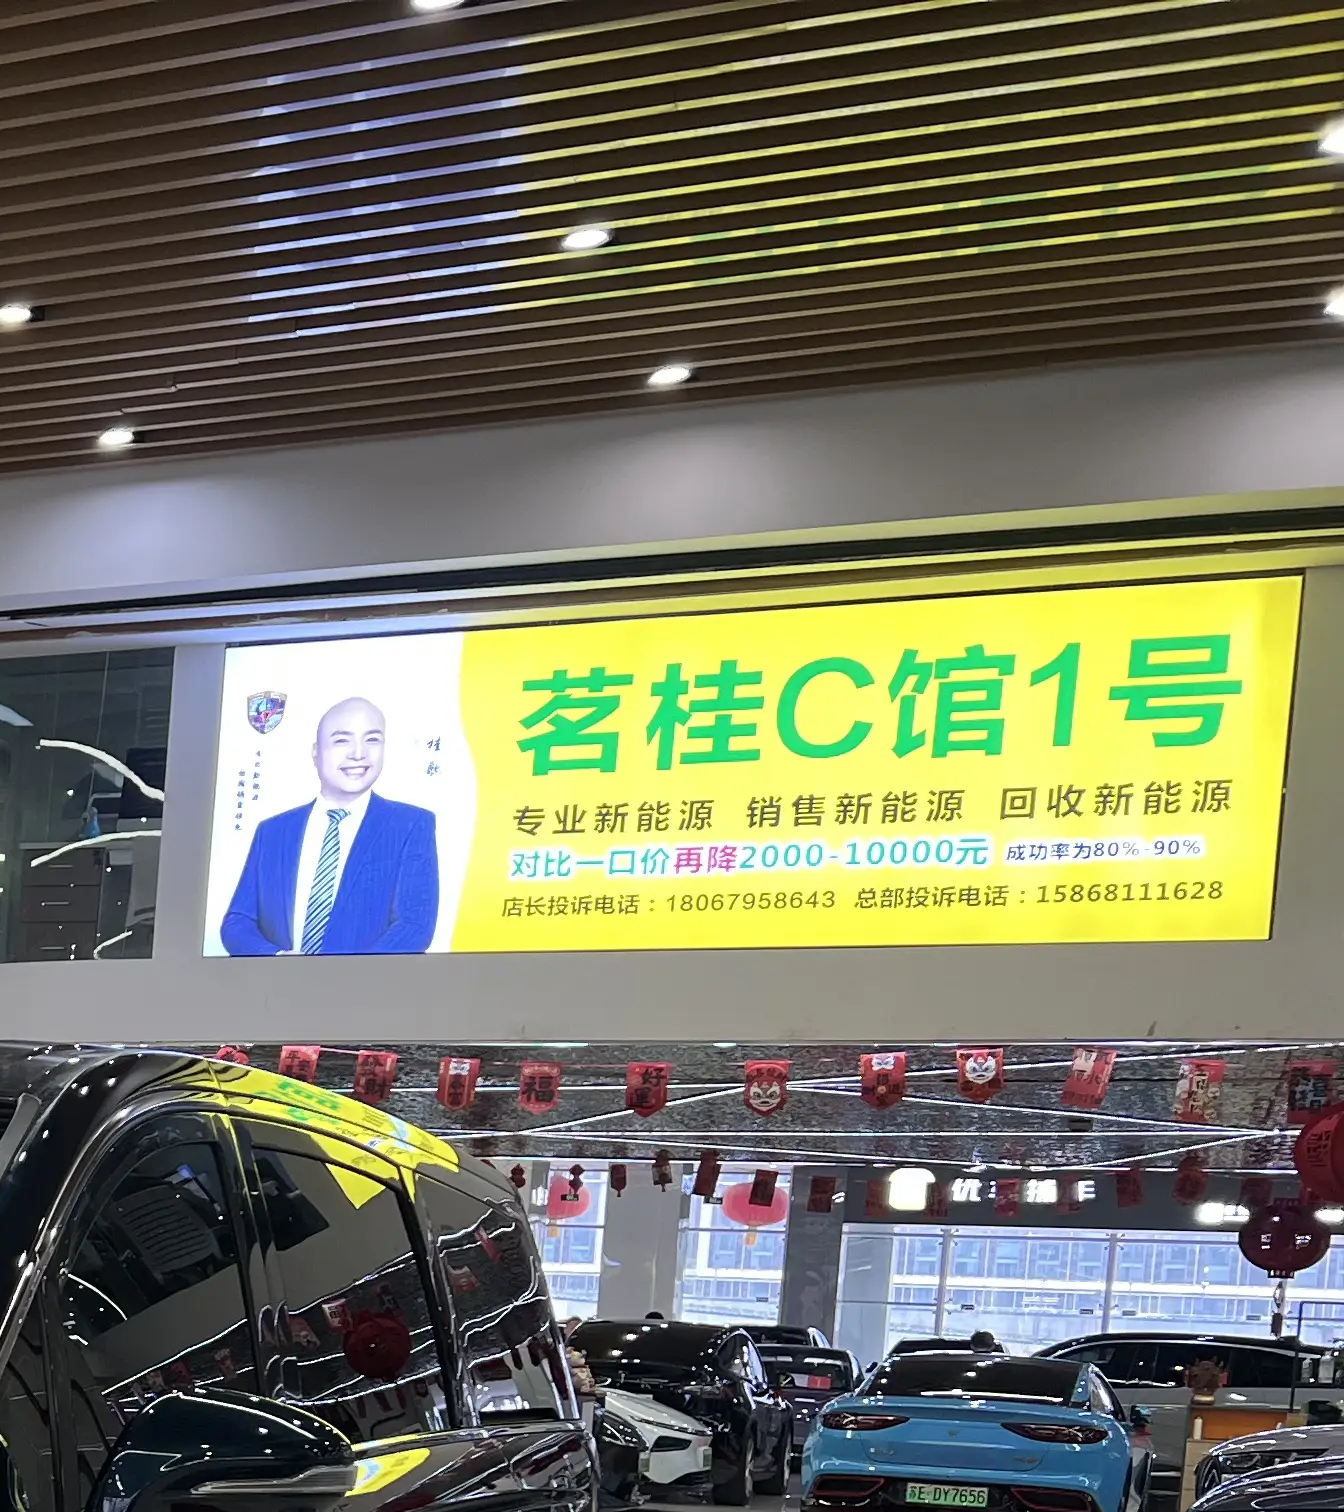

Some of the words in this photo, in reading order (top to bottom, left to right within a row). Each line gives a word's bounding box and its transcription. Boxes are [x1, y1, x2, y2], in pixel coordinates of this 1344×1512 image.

[515, 632, 1243, 777] 茗桂C馆1号
[512, 799, 715, 836] 专业新能源
[746, 789, 965, 828] 销售新能源
[999, 778, 1233, 820] 回收新能源
[511, 838, 989, 878] 对比一口价再降2000-10000元
[1006, 839, 1201, 861] 成功率为80%-90%
